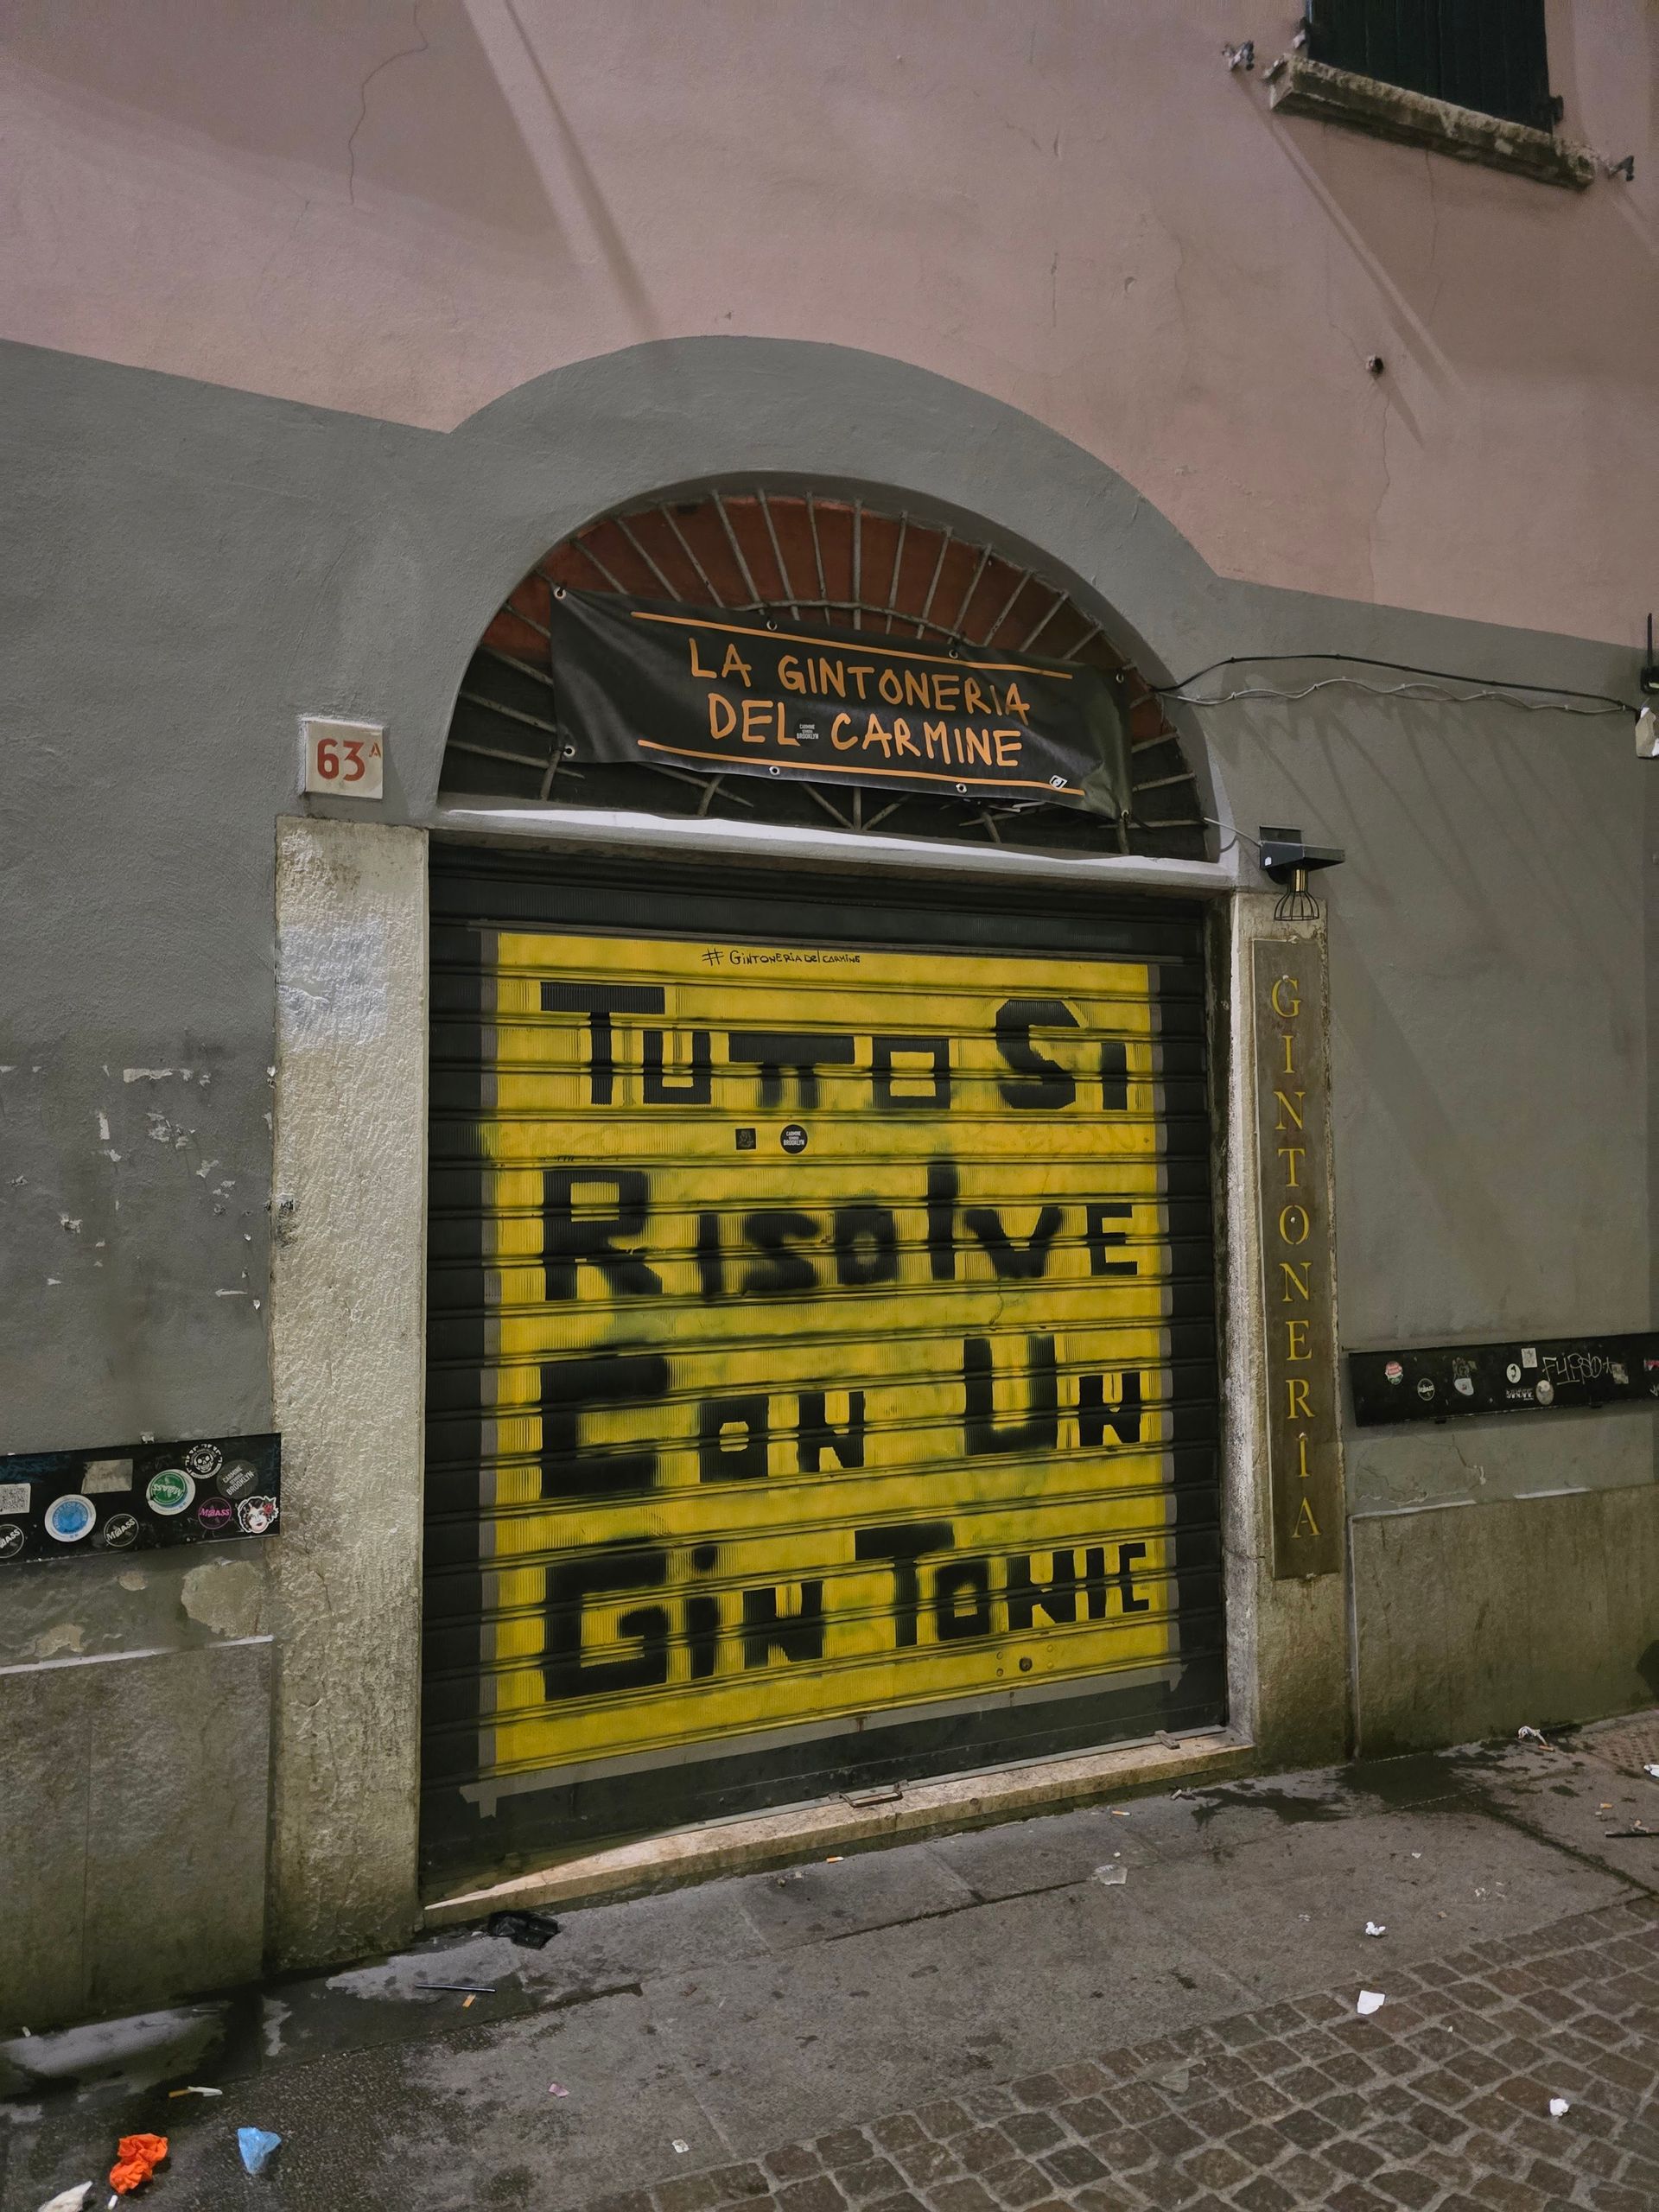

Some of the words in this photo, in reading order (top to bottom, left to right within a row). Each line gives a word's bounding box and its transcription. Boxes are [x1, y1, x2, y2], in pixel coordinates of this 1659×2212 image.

[689, 638, 752, 688] LA
[778, 654, 1030, 727] GINTONERIA
[707, 692, 802, 747] DEL
[830, 712, 1023, 768] CARMINE
[540, 982, 951, 1110] TUTTO
[1270, 976, 1321, 1539] GINTONERIA
[541, 1353, 865, 1498] CON
[963, 1334, 1142, 1455] UN
[226, 1471, 255, 1496] BROOKLYN
[854, 1521, 1150, 1648] TONIC
